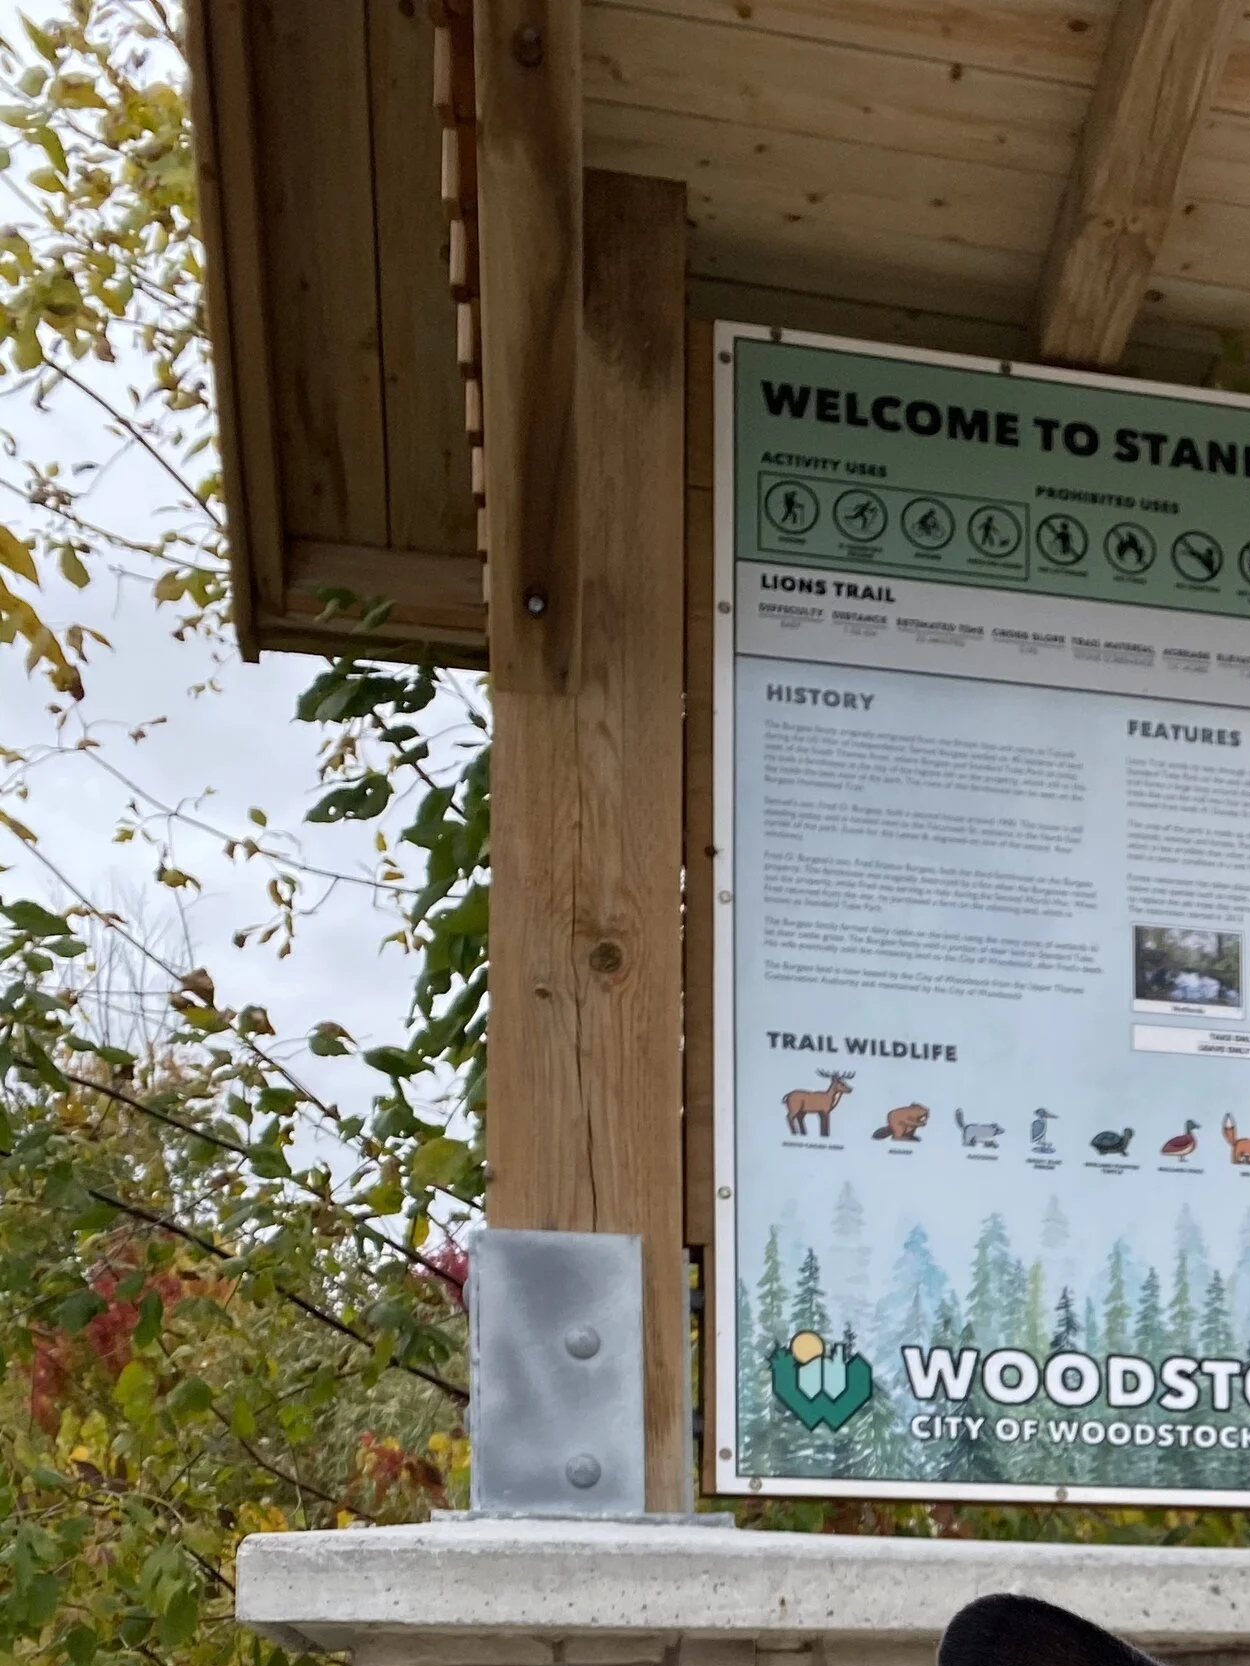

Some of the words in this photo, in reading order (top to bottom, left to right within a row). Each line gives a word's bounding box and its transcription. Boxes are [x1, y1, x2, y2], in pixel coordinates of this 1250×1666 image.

[761, 380, 1020, 447] WELCOME
[1034, 418, 1099, 457] TO
[761, 452, 841, 471] ACTIVITY
[845, 461, 888, 478] USES
[1035, 485, 1136, 509] PROHIBITED
[1139, 497, 1181, 515] USES
[761, 573, 827, 597] LIONS
[833, 581, 896, 604] TRAIL
[766, 684, 875, 711] HISTORY
[1127, 719, 1242, 748] FEATURES
[767, 1031, 838, 1055] TRAIL
[844, 1036, 958, 1063] WILDLIFE
[910, 1415, 987, 1442] CITY
[995, 1418, 1038, 1443] OF
